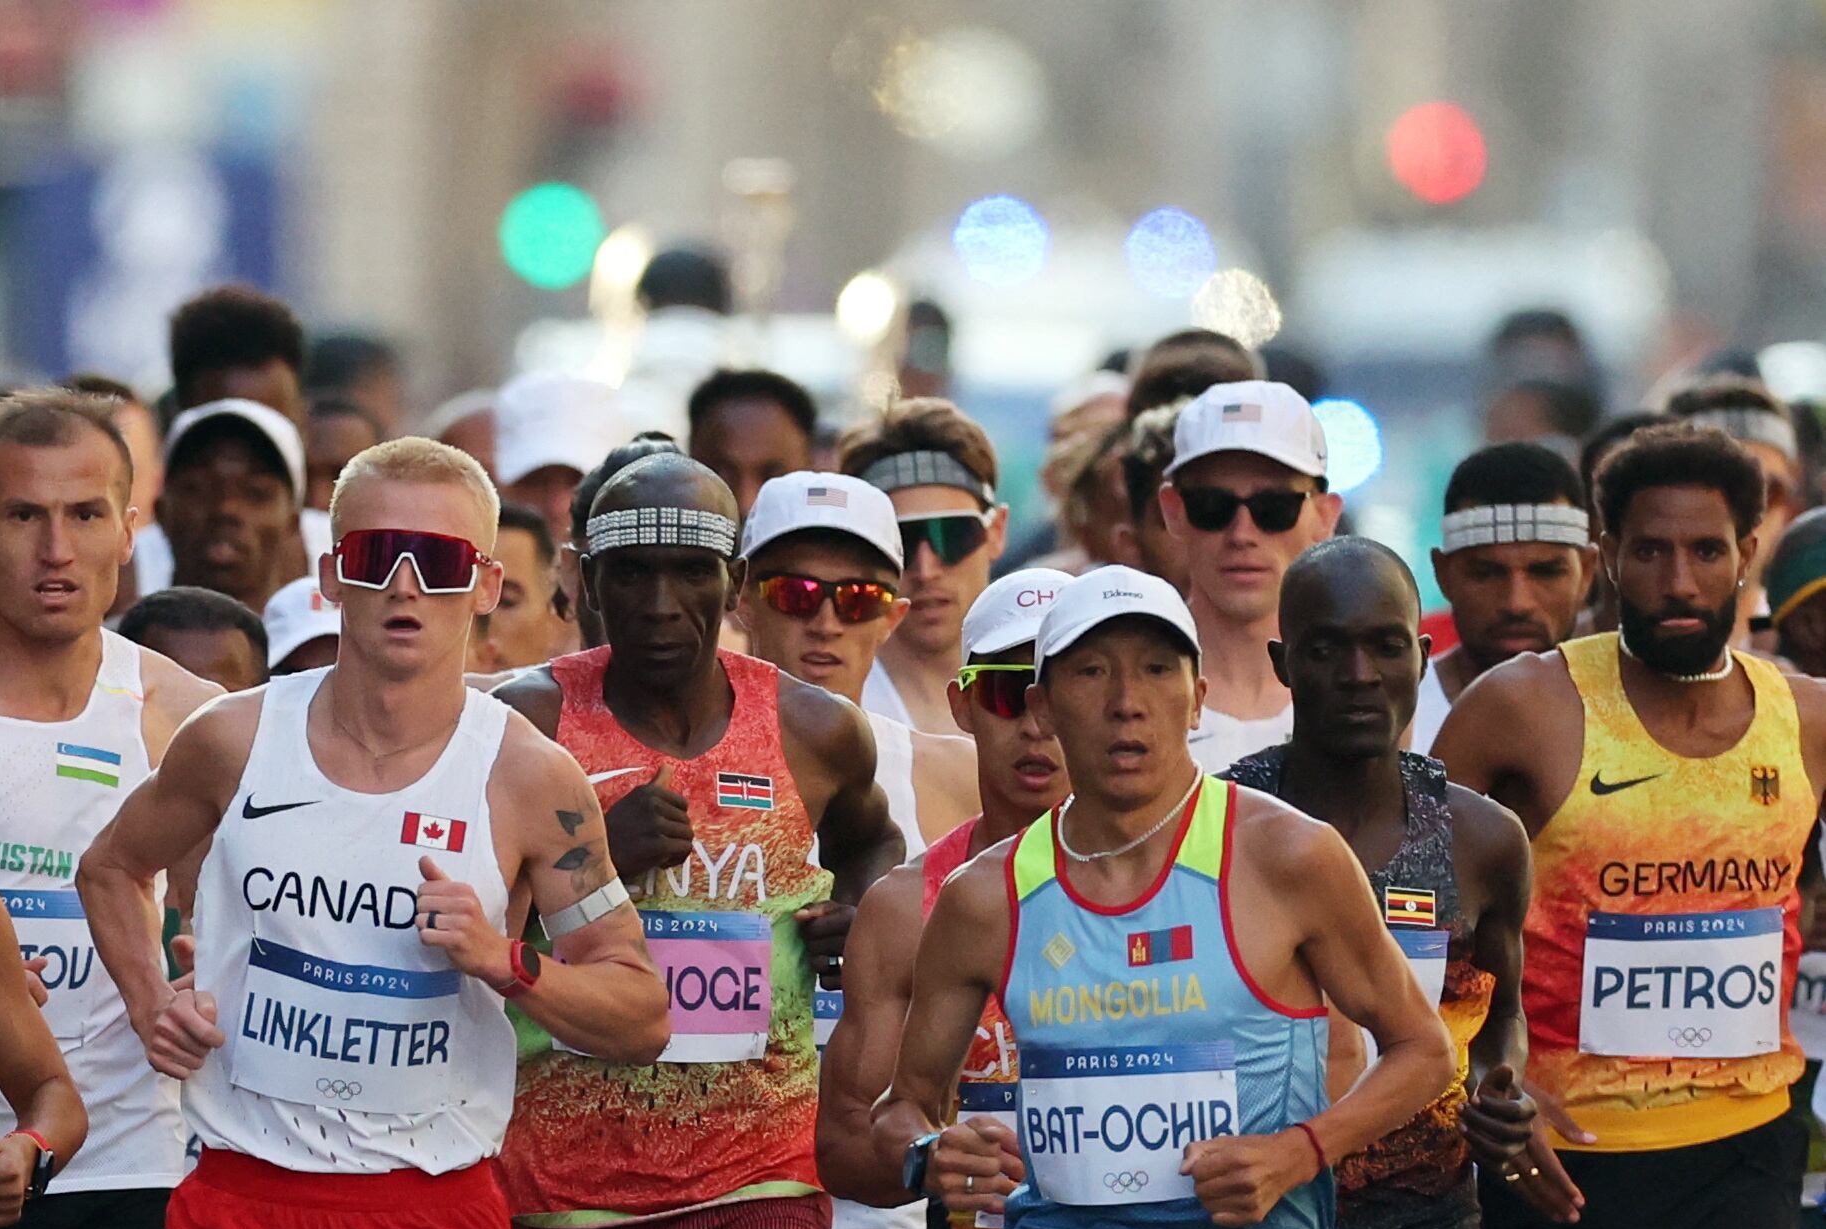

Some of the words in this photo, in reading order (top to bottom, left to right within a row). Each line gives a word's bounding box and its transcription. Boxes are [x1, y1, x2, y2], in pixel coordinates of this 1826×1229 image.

[1017, 590, 1054, 607] CH
[1600, 859, 1791, 897] GERMANY
[242, 868, 418, 930] CANAD
[671, 920, 718, 932] 2024
[1644, 920, 1694, 934] PARIS
[1701, 919, 1745, 932] 2024
[303, 961, 353, 986] PARIS
[360, 974, 409, 991] 2024
[1593, 960, 1775, 1010] PETROS
[1030, 974, 1206, 1025] MONGOLIA
[242, 992, 450, 1067] LINKLETTER
[1066, 1055, 1118, 1070] PARIS
[1126, 1055, 1174, 1068] 2024
[1027, 1100, 1234, 1154] BAT-OCHIR
